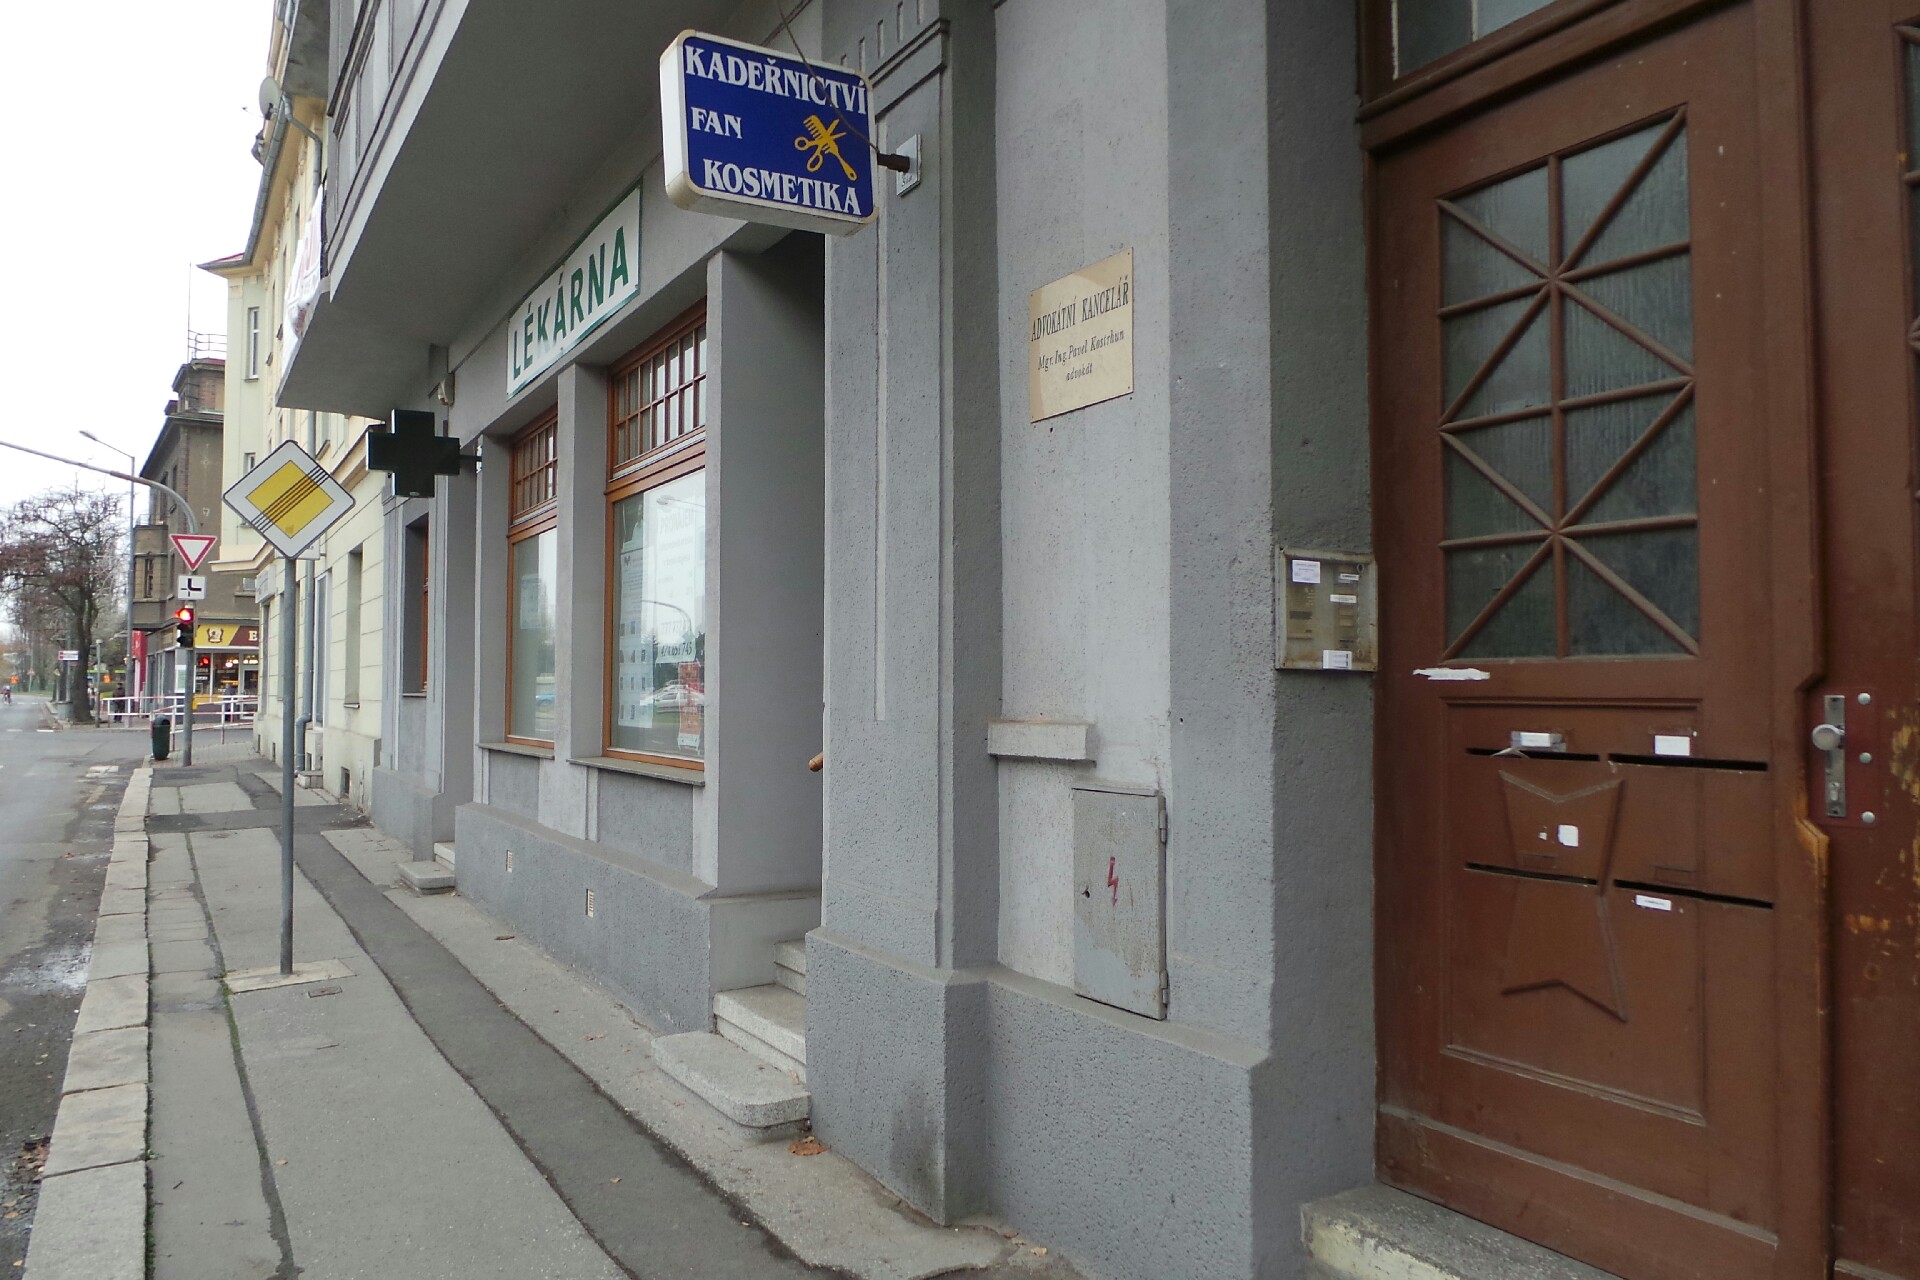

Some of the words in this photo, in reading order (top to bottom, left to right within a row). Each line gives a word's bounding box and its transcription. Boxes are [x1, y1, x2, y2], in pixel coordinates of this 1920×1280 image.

[684, 45, 867, 115] KADEŘNICTVÍ
[690, 106, 743, 139] FAN
[703, 158, 862, 215] KOSMETIKA
[513, 225, 629, 380] LÉKÁRNA
[1031, 295, 1077, 342] ADVOKÁTNÍ
[1082, 274, 1129, 322] KANCELÁŘ
[1038, 355, 1053, 372] Mgr.
[1068, 340, 1088, 359] Pavel
[1066, 362, 1093, 381] advokát
